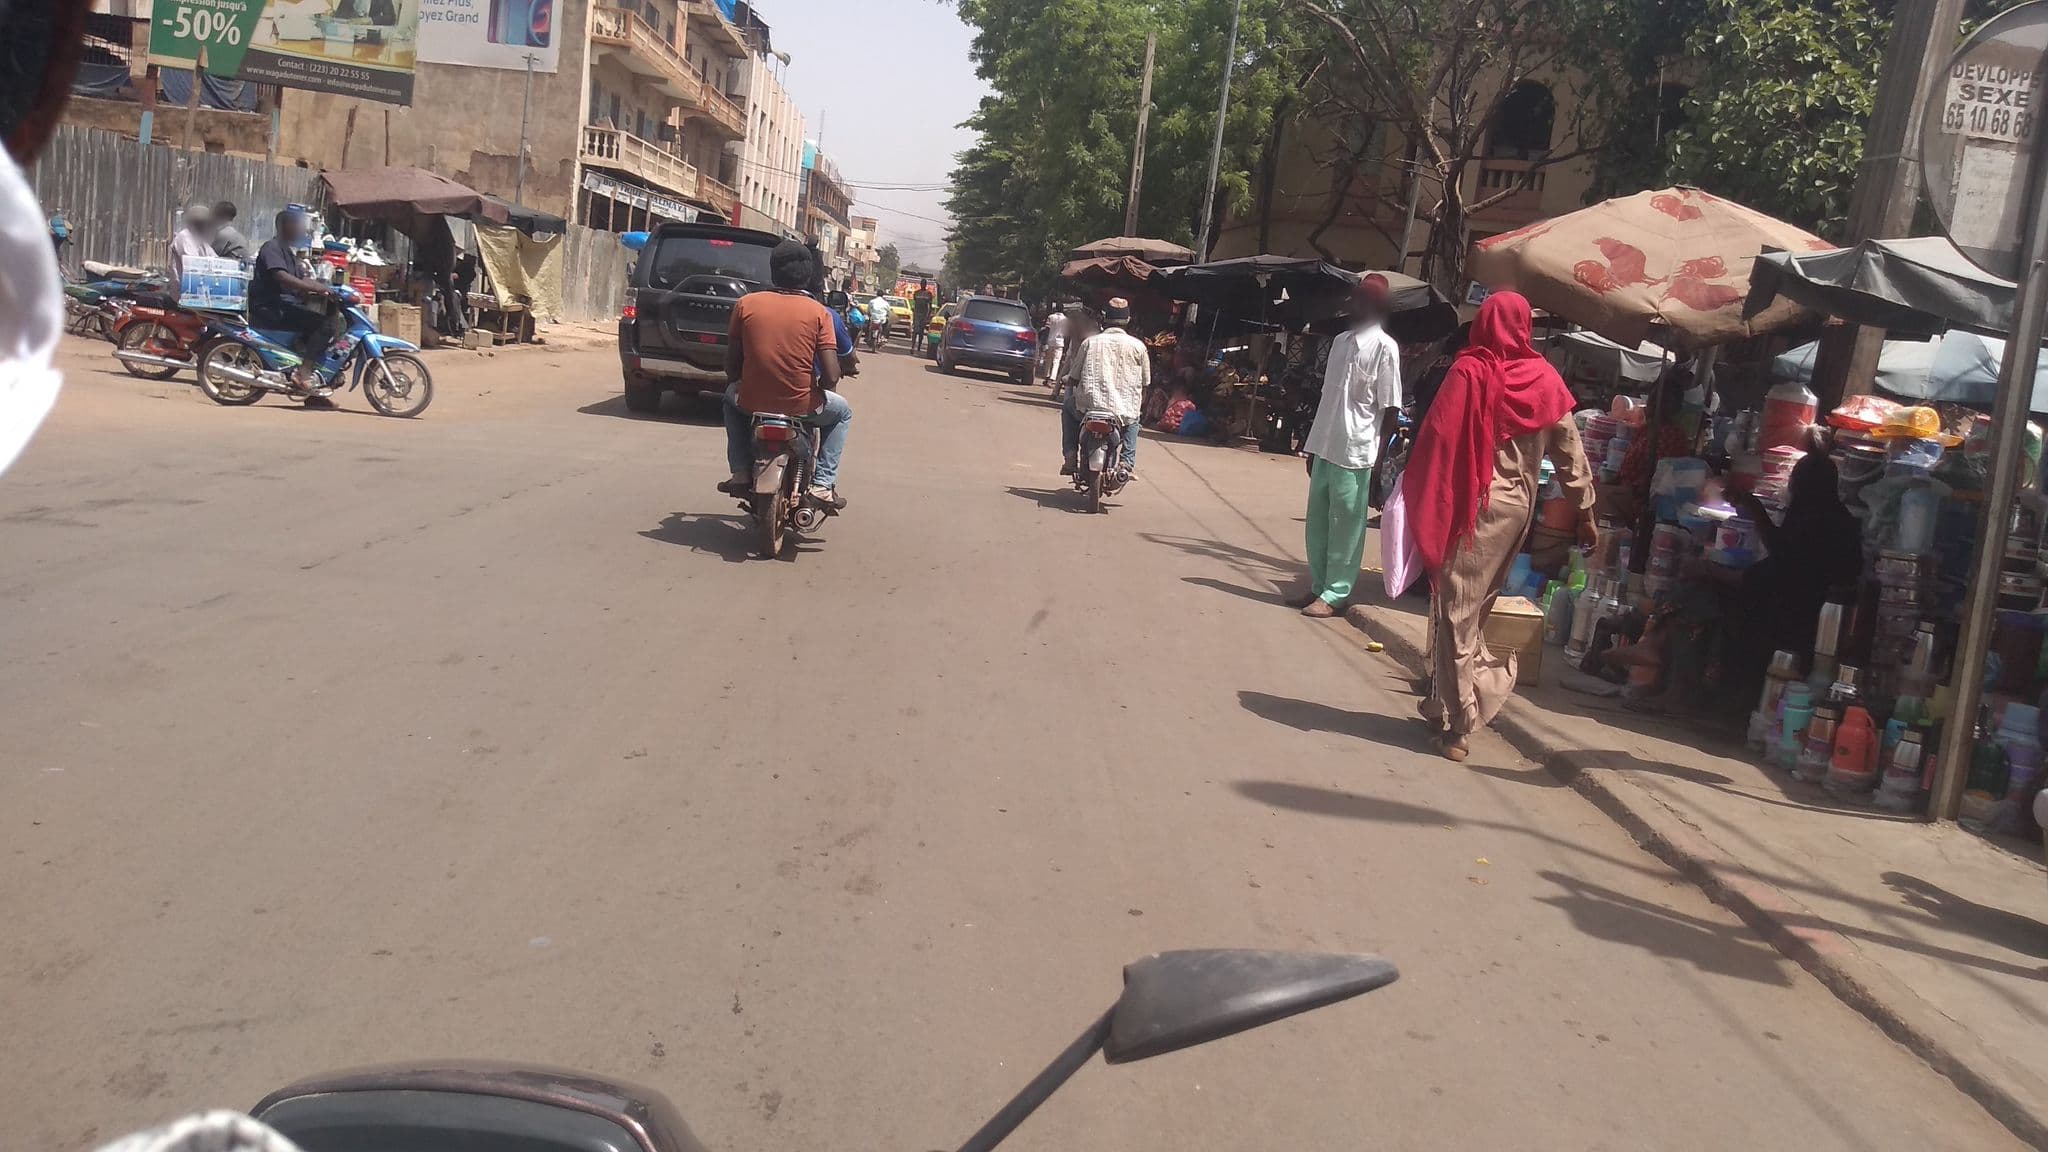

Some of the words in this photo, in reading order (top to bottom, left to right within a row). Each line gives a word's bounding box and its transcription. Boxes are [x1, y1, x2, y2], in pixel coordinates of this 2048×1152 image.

[163, 6, 241, 46] -50%
[445, 10, 479, 23] Grand
[278, 58, 304, 71] Contact
[309, 63, 329, 75] (223)
[329, 66, 339, 76] 20
[340, 68, 350, 78] 22
[1959, 84, 2031, 108] SEXE
[1946, 102, 1966, 130] 65
[1970, 105, 1988, 133] 10
[1991, 108, 2010, 136] 68
